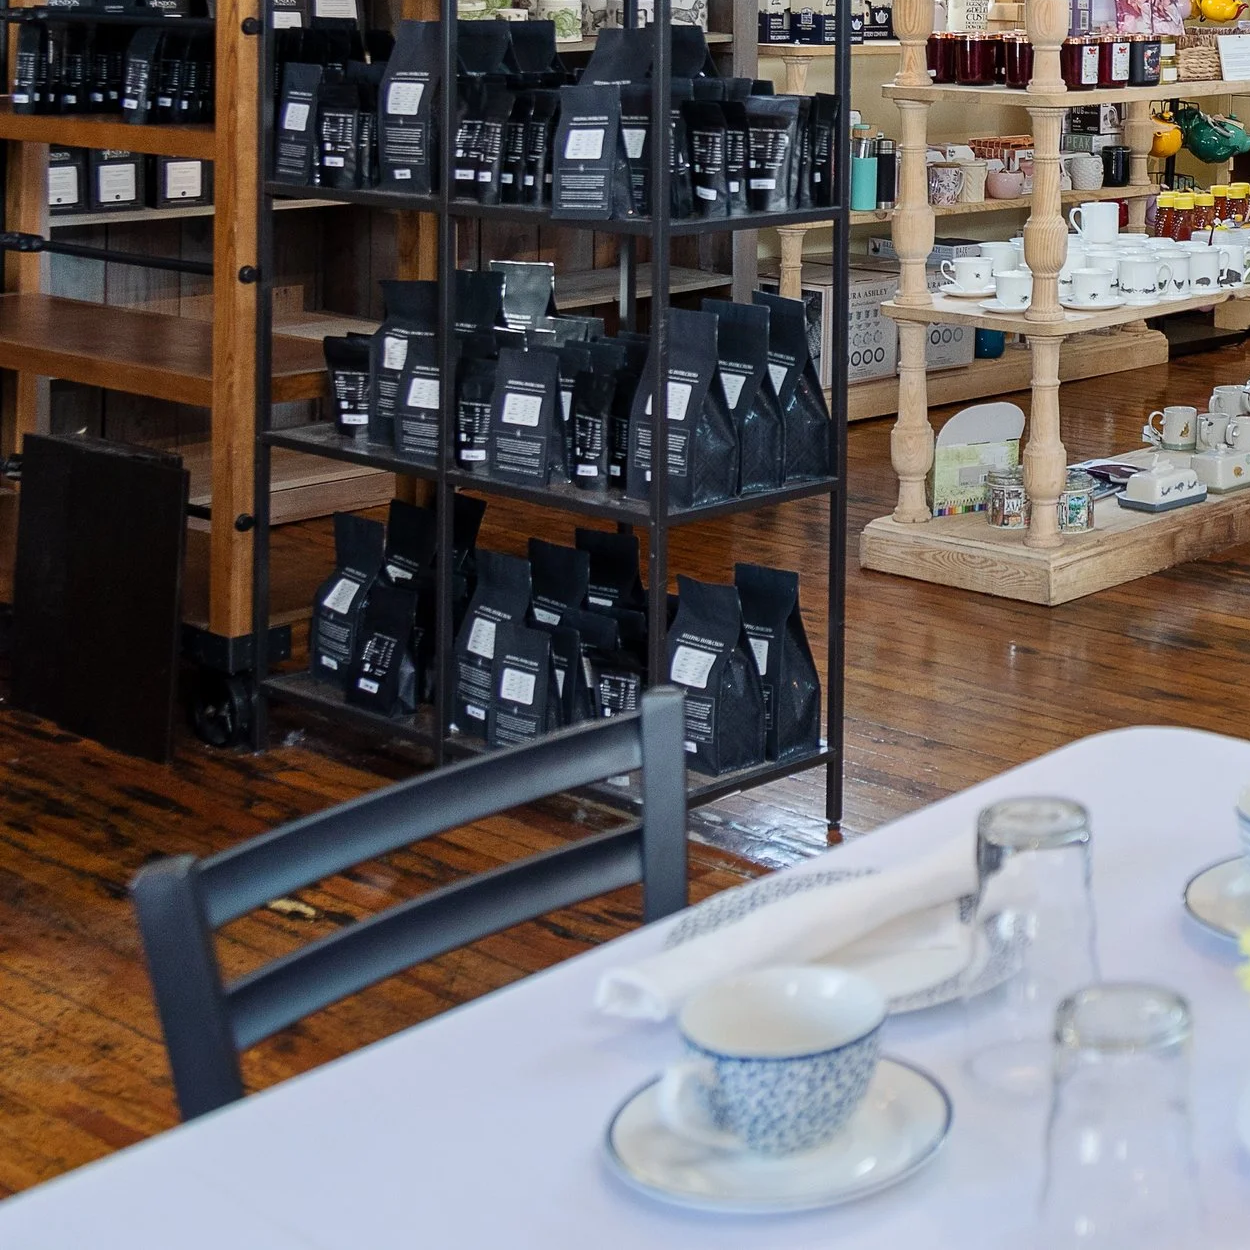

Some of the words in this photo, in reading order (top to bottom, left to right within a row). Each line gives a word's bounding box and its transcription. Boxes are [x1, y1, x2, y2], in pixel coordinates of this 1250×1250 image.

[1072, 107, 1084, 115] MUG
[1066, 137, 1091, 150] PEAK
[863, 288, 888, 298] ASHLEY
